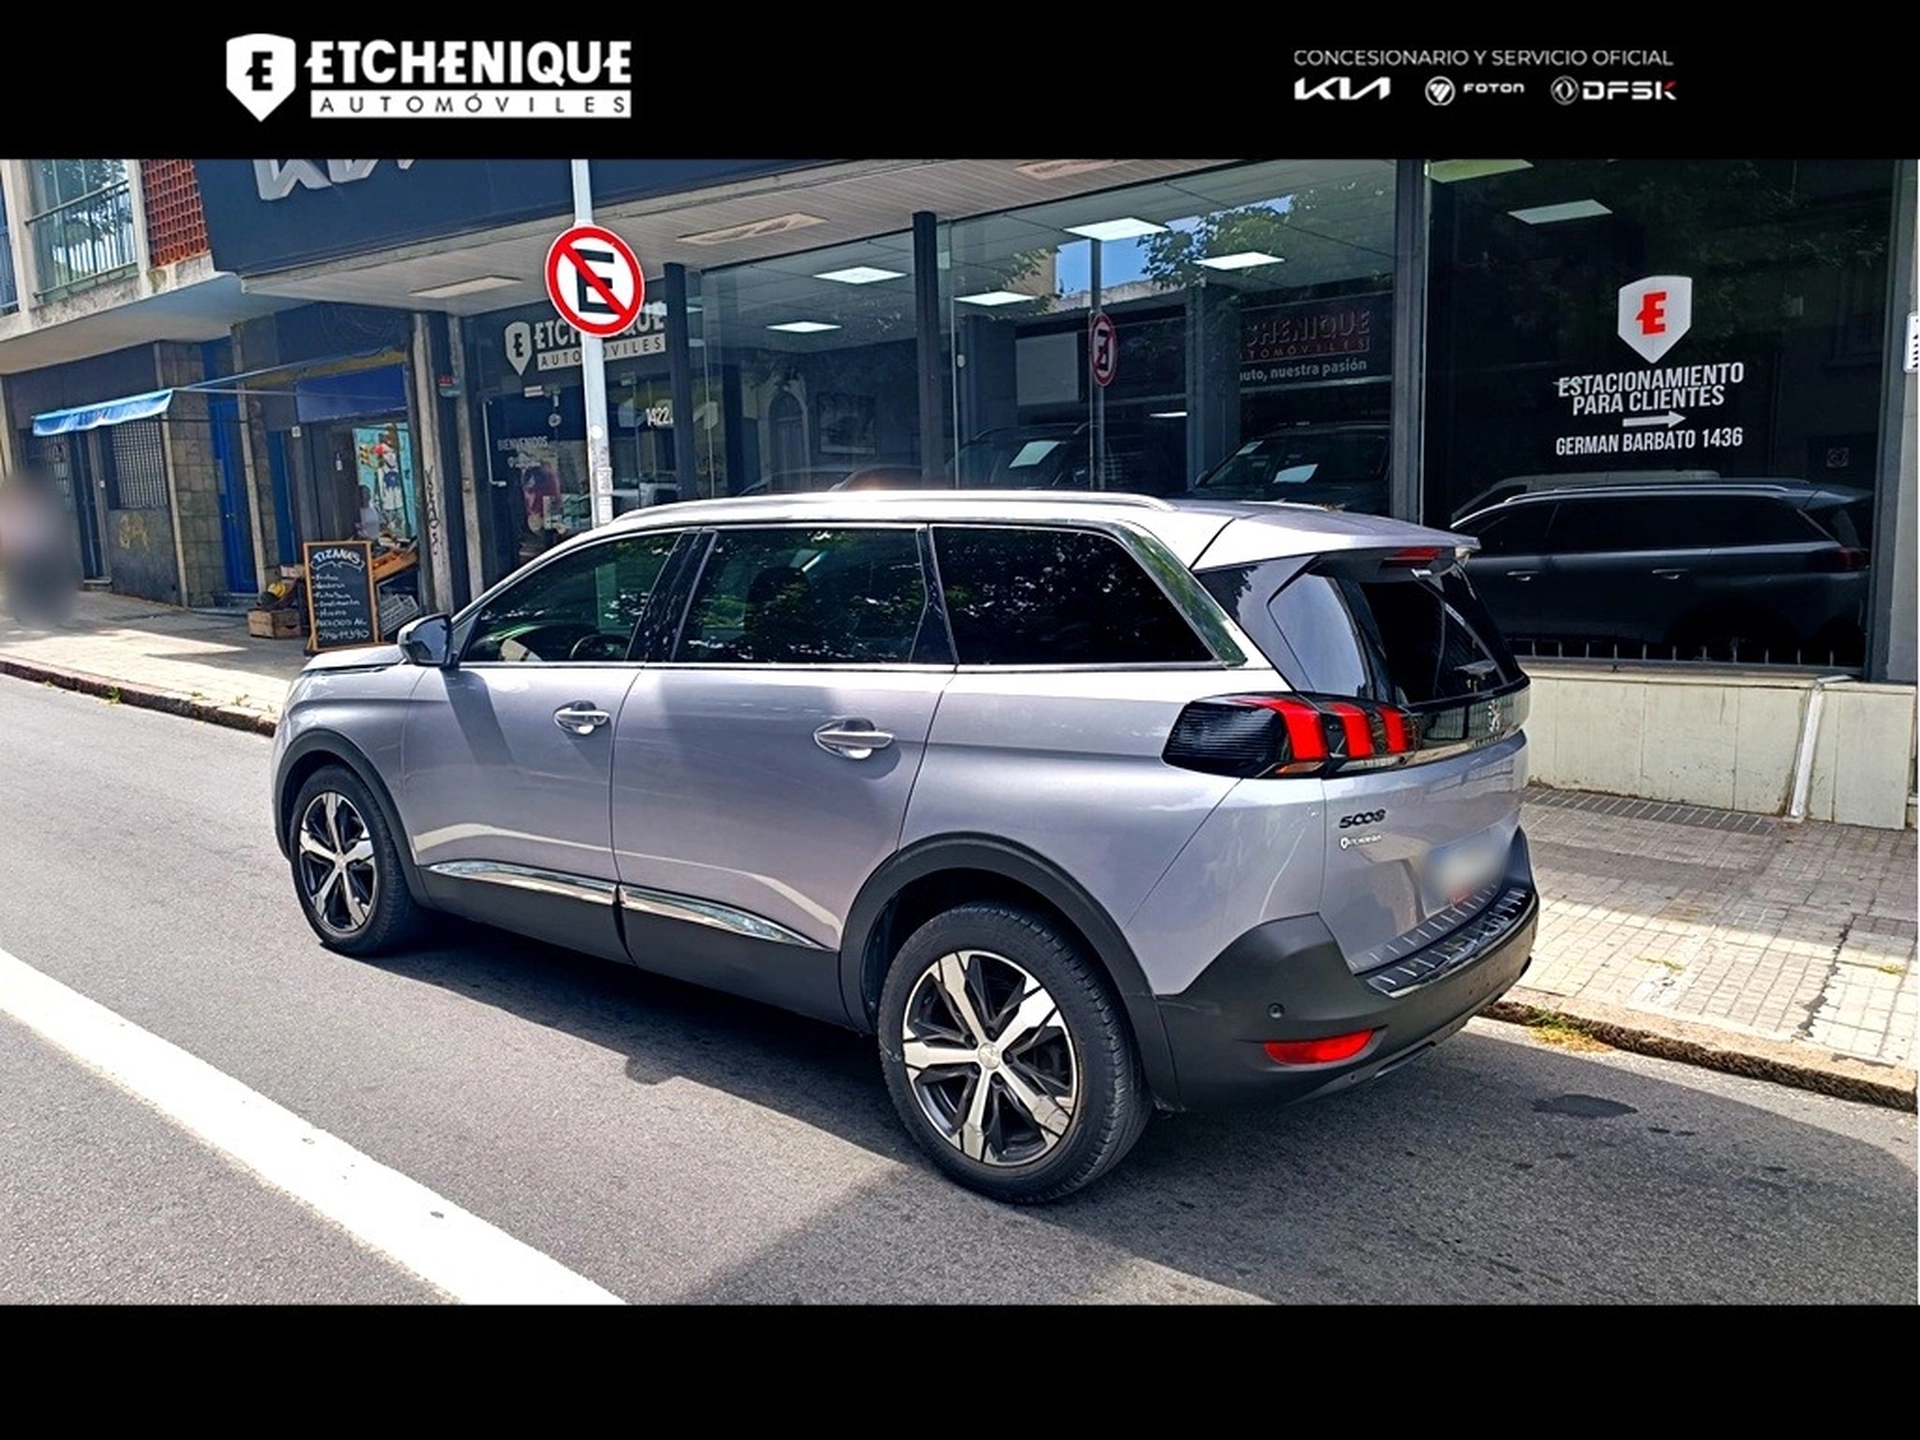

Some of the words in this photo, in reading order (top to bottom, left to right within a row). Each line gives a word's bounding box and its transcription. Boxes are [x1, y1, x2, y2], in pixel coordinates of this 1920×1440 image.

[574, 248, 620, 315] E
[1270, 364, 1320, 379] nuestra
[1322, 357, 1367, 377] pasión
[1558, 362, 1744, 397] ESTACIONAMIENTO
[1573, 391, 1624, 416] PARA
[1628, 385, 1725, 411] CLIENTES
[1556, 434, 1619, 456] GERMAN
[1623, 429, 1696, 452] BARBATO
[1702, 427, 1743, 447] 1436
